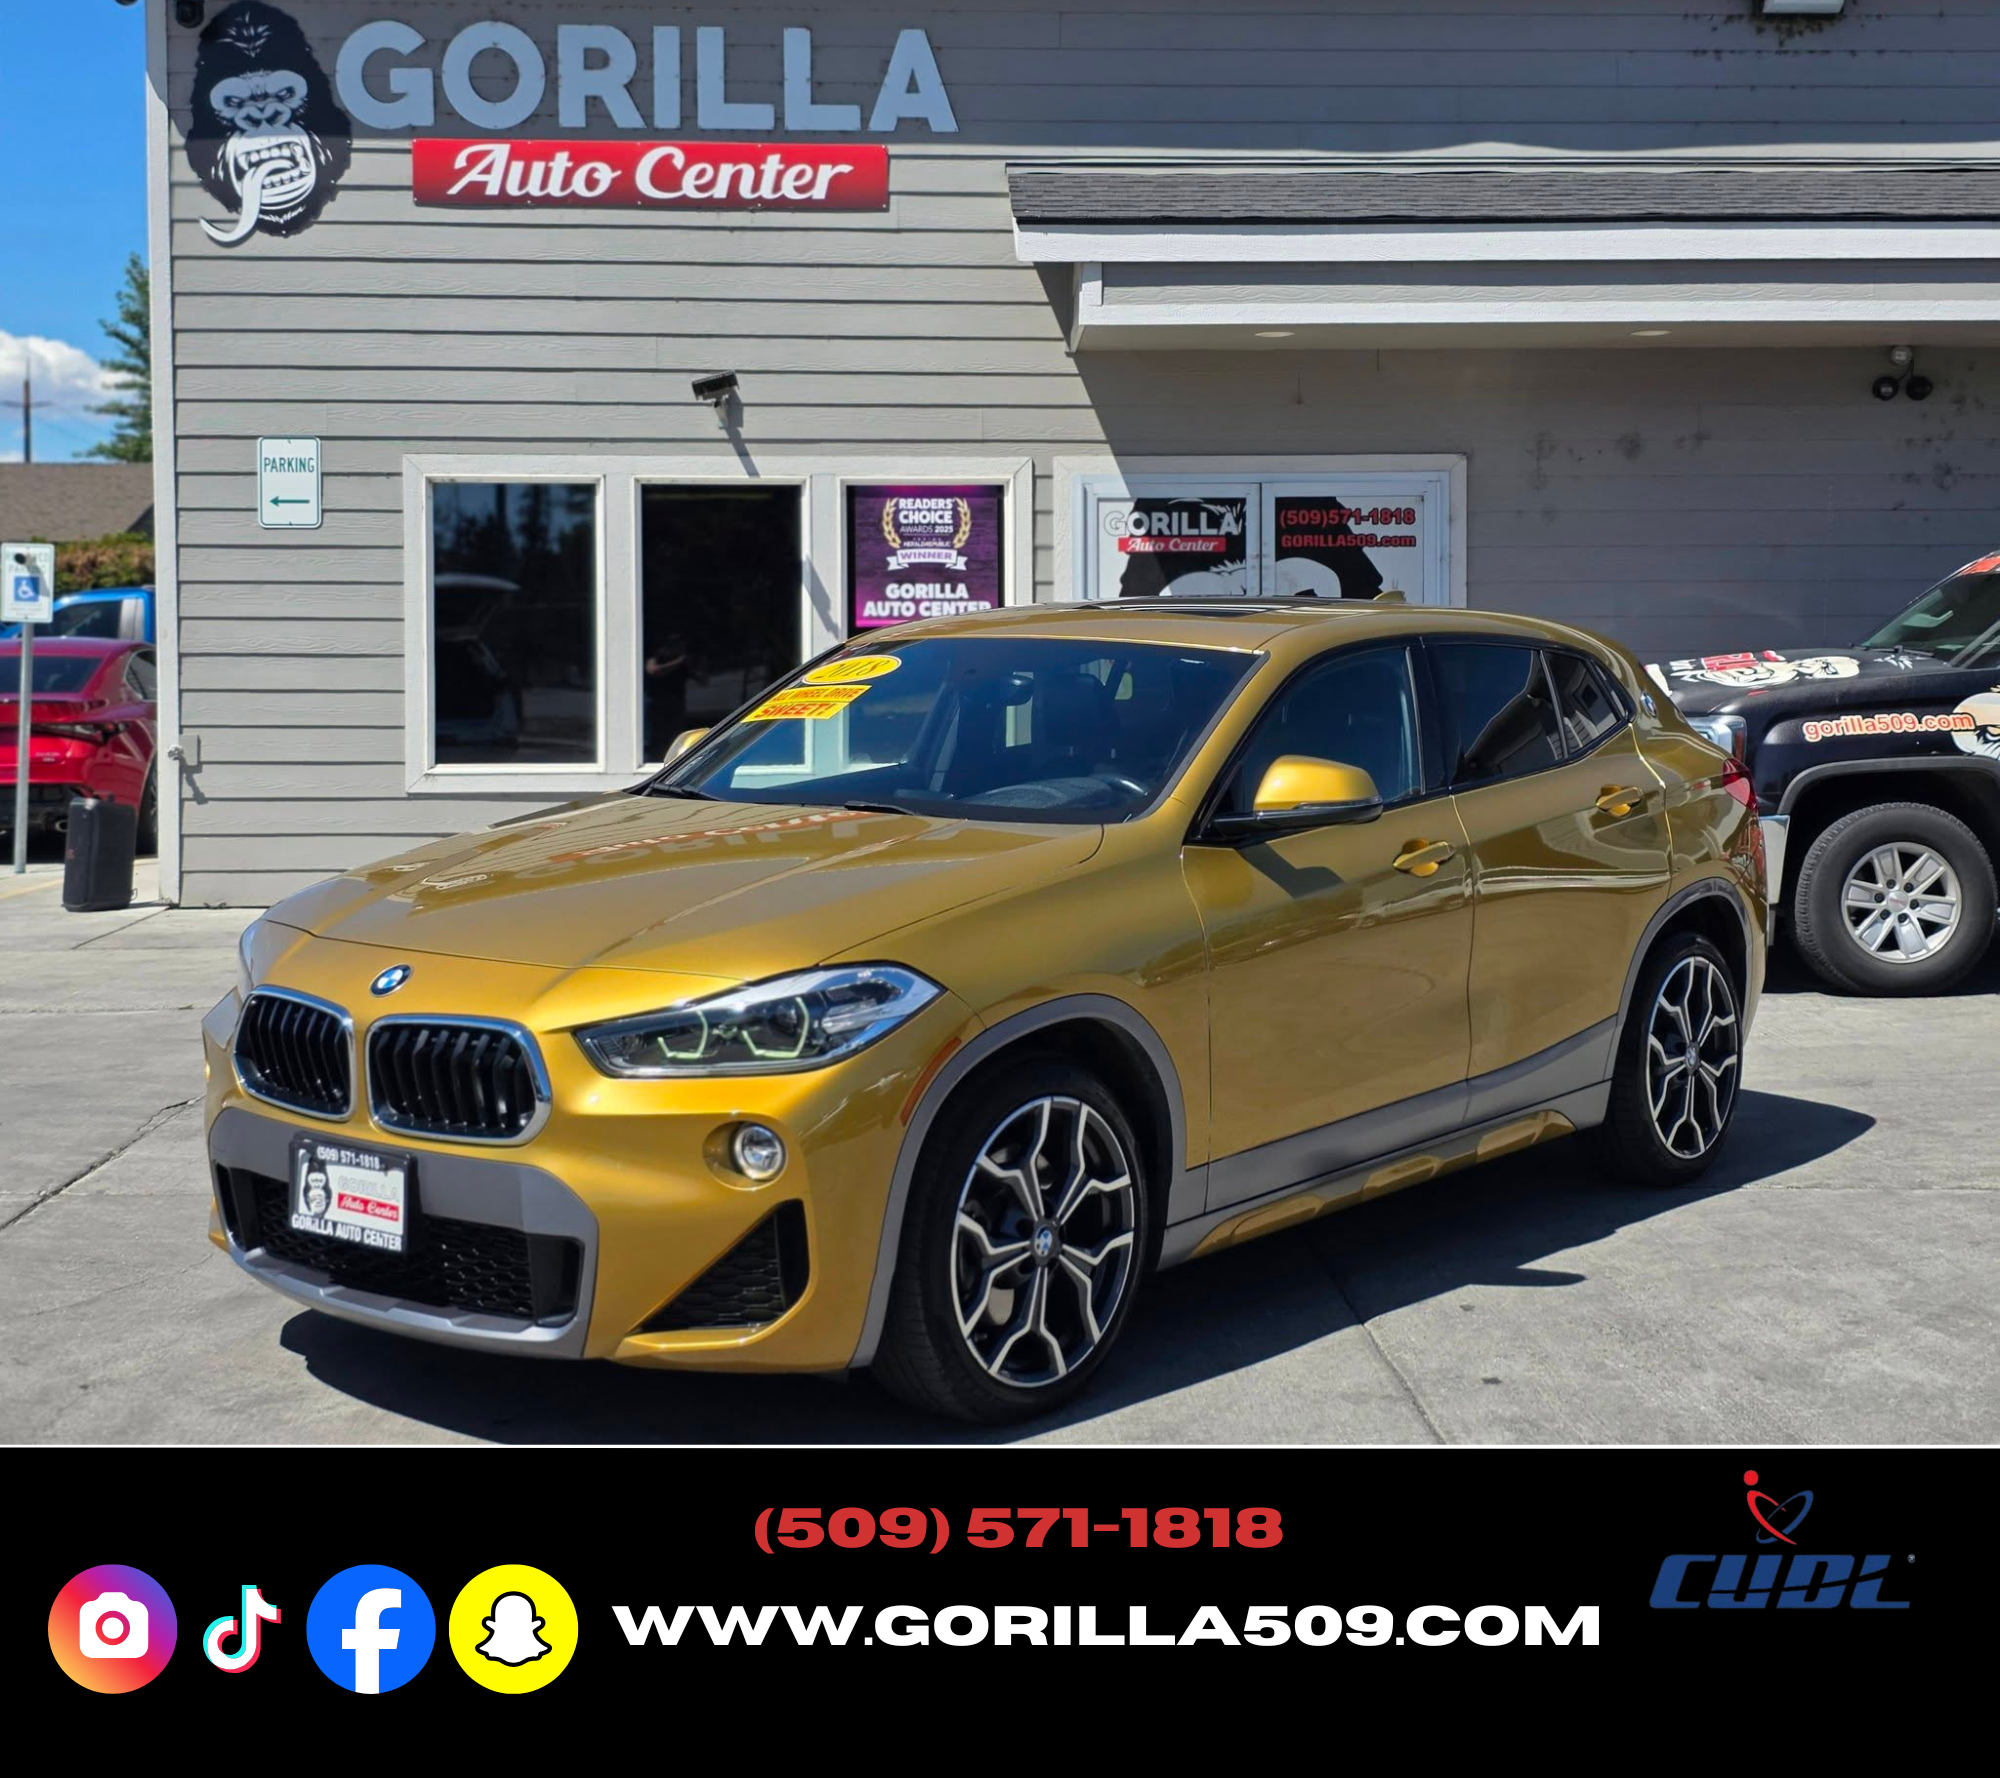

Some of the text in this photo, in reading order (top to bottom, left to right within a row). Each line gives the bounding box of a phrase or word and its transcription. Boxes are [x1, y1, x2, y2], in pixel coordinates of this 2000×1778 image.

[335, 20, 959, 132] GORILLA
[447, 143, 853, 199] Auto Center
[264, 457, 315, 473] PARKING
[898, 498, 955, 509] READERS'
[899, 511, 953, 524] CHOICE
[1104, 511, 1240, 536] GORILLA
[1280, 507, 1416, 528] (509)571-1818
[900, 525, 953, 533] AWARDS 2025
[1127, 538, 1218, 552] Auto Center
[1281, 533, 1417, 548] GORILLA509.com
[900, 551, 953, 560] WINNER
[885, 583, 969, 599] GORILLA
[863, 601, 916, 617] AUTO
[1804, 714, 1974, 741] gorilla509.com
[317, 1146, 338, 1161] (509)
[335, 1223, 361, 1242] AUTO
[363, 1229, 402, 1251] CENTER
